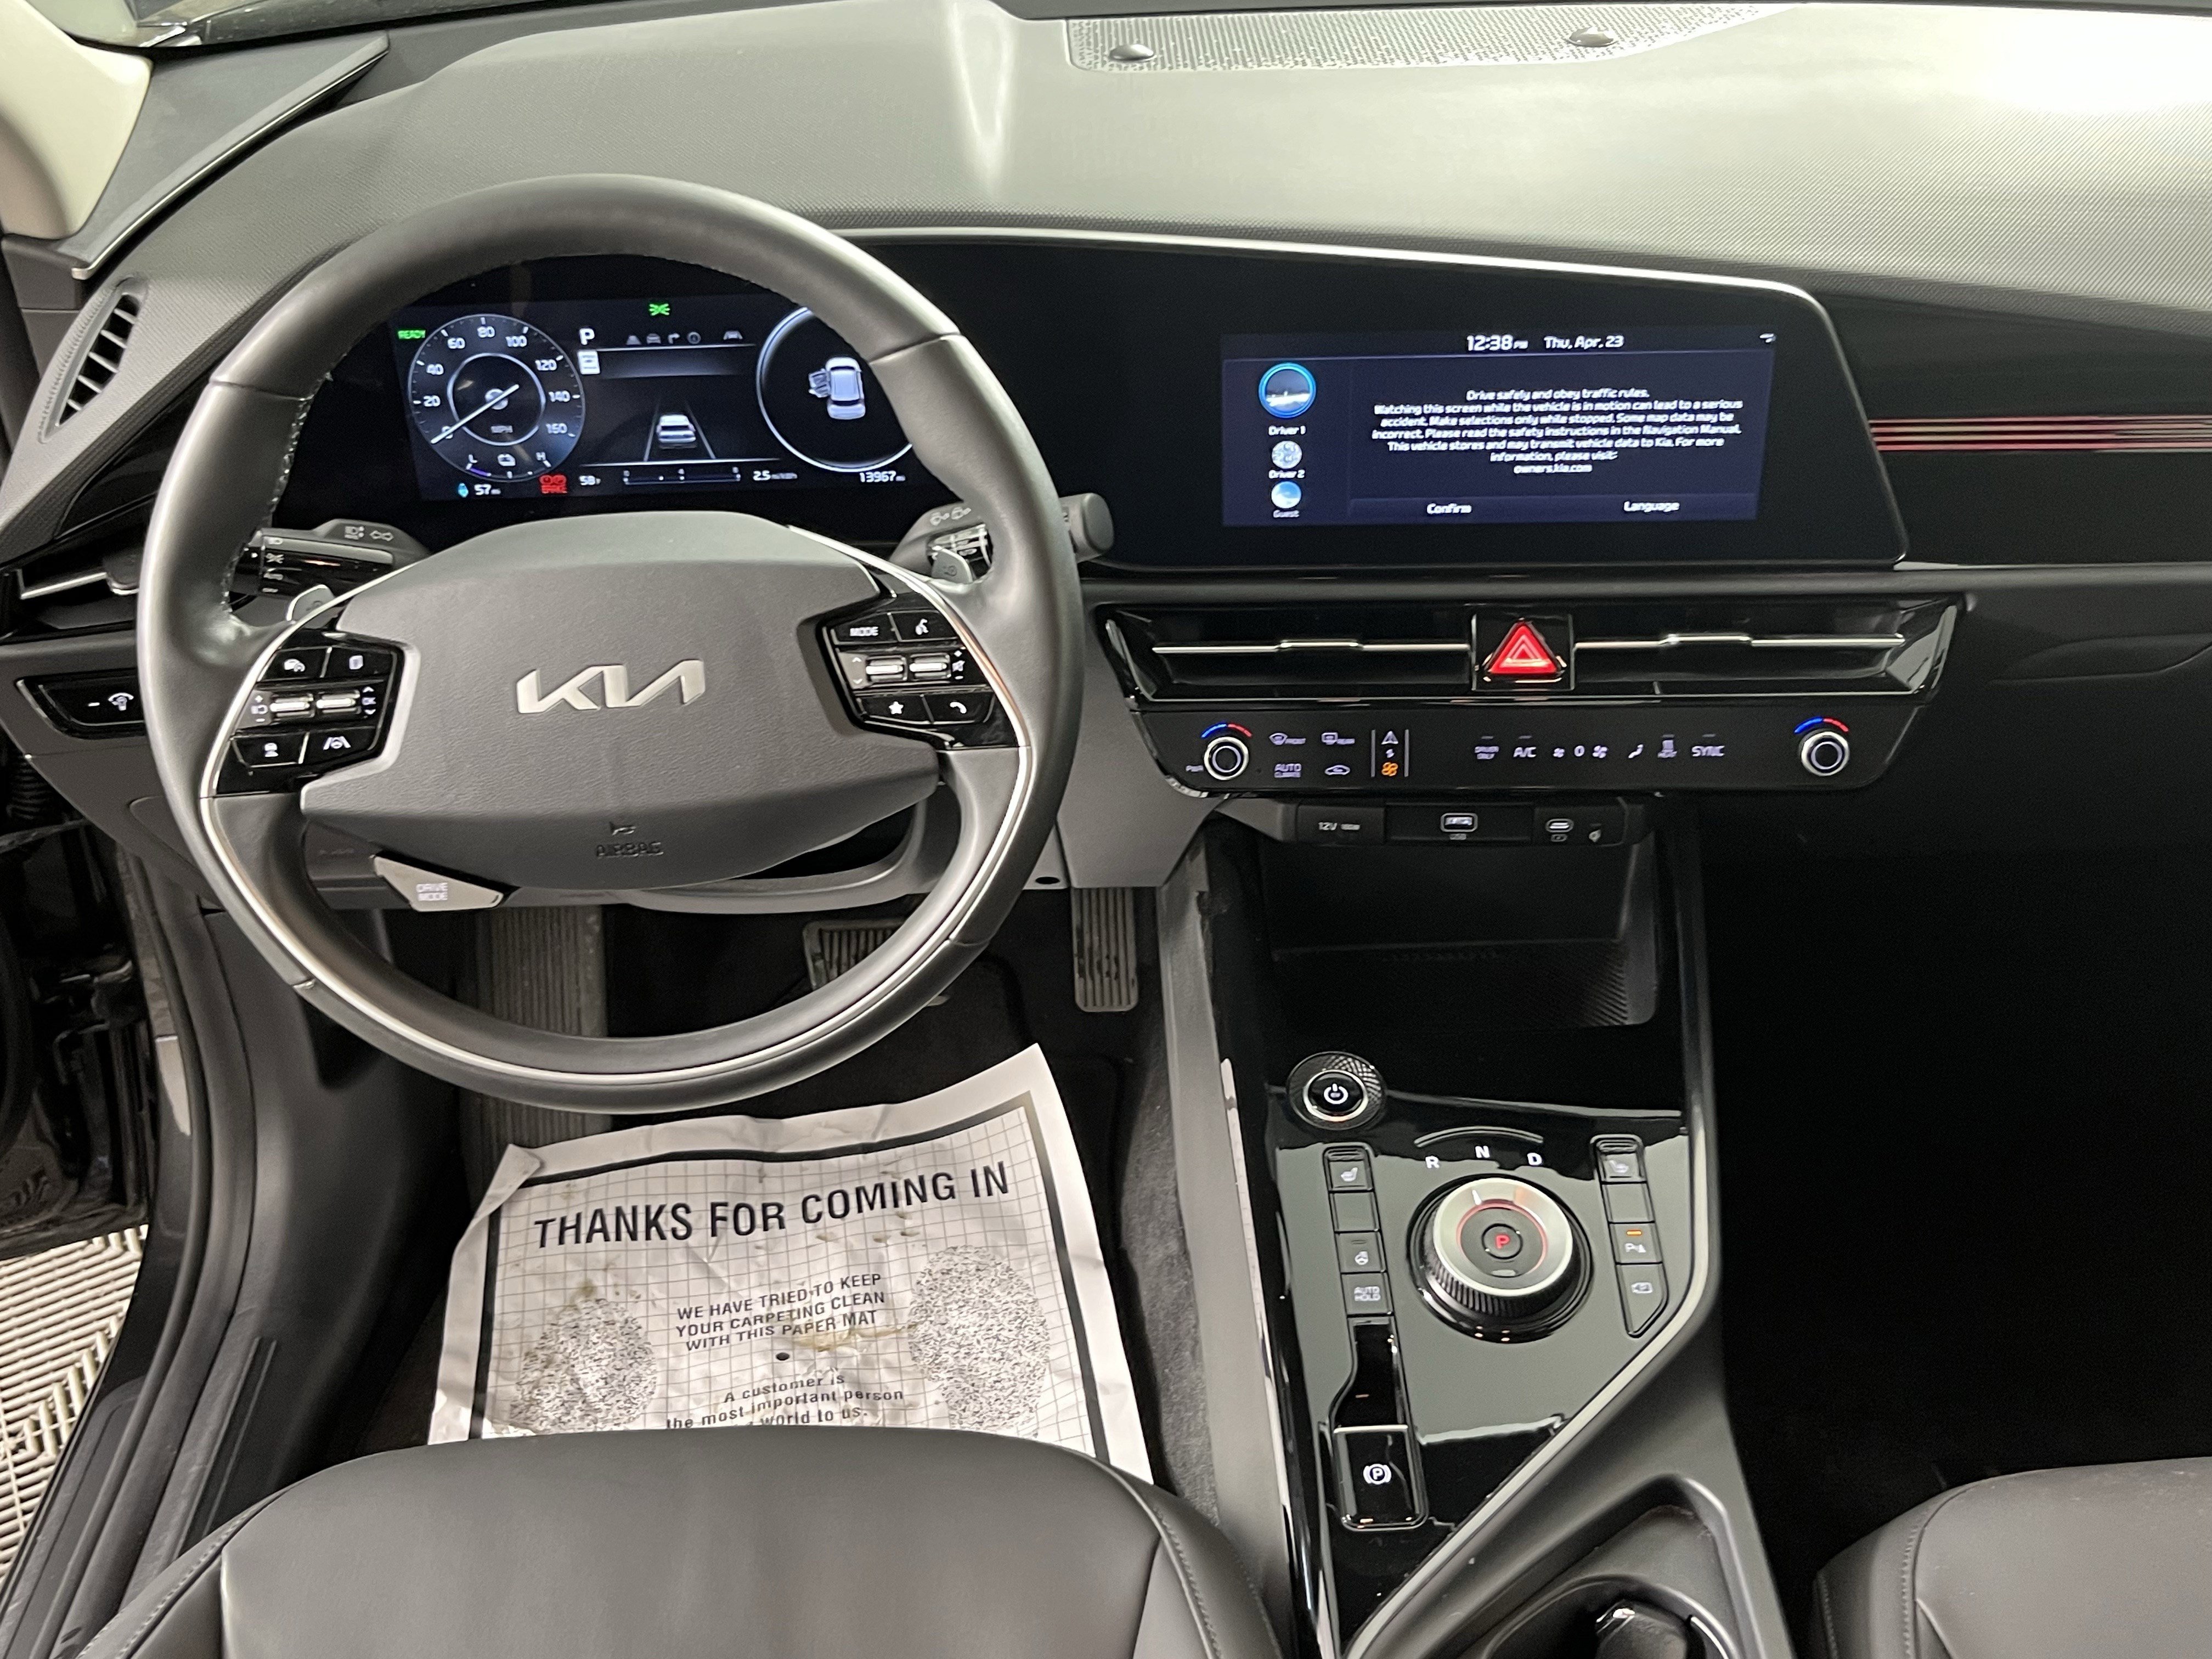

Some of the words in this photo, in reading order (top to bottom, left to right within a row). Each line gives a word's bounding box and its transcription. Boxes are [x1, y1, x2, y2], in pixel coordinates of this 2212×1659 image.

[477, 326, 495, 338] 80
[579, 328, 595, 345] P
[505, 336, 527, 347] 100
[1466, 334, 1513, 351] 12:38
[1605, 334, 1624, 348] 23
[535, 359, 557, 371] 120
[1466, 390, 1496, 400] Drive
[1553, 389, 1581, 400] obey
[1582, 388, 1618, 398] traffic
[423, 395, 441, 407] 20
[1512, 403, 1531, 412] the
[1678, 400, 1692, 410] to
[1514, 415, 1539, 425] only
[1268, 425, 1297, 436] Driver
[1300, 425, 1306, 436] 1
[1488, 427, 1508, 437] the
[1387, 441, 1410, 451] This
[1297, 469, 1305, 479] 2
[474, 483, 492, 495] 57
[1426, 503, 1472, 515] Confirm
[1624, 500, 1680, 512] Language
[516, 659, 706, 714] KIA
[1513, 747, 1537, 758] A/C
[1691, 745, 1725, 757] SYNC
[1274, 763, 1301, 772] AUTO
[1475, 1146, 1490, 1158] N
[1425, 1155, 1440, 1169] R
[1527, 1153, 1542, 1165] D
[534, 1203, 693, 1249] THANKS
[710, 1201, 786, 1238] FOR
[802, 1172, 956, 1223] COMING
[970, 1160, 1009, 1198] IN
[1496, 1234, 1510, 1249] P
[678, 1306, 704, 1320] WE
[710, 1299, 753, 1317] HAVE
[759, 1288, 808, 1308] TRIED
[813, 1280, 834, 1297] TO
[840, 1273, 881, 1290] KEEP
[676, 1321, 724, 1338] YOUR
[730, 1302, 825, 1329] CARPETING
[831, 1291, 885, 1310] CLEAN
[686, 1334, 730, 1351] WITH
[738, 1326, 775, 1342] THIS
[782, 1317, 837, 1336] PAPER
[843, 1310, 878, 1327] MAT
[724, 1392, 735, 1404] A
[742, 1376, 823, 1400] customer
[830, 1371, 845, 1385] is
[667, 1417, 693, 1429] the
[702, 1406, 744, 1426] most
[751, 1390, 837, 1414] important
[844, 1389, 904, 1403] person
[760, 1410, 811, 1426] world
[817, 1409, 834, 1423] to
[842, 1407, 868, 1420] us.
